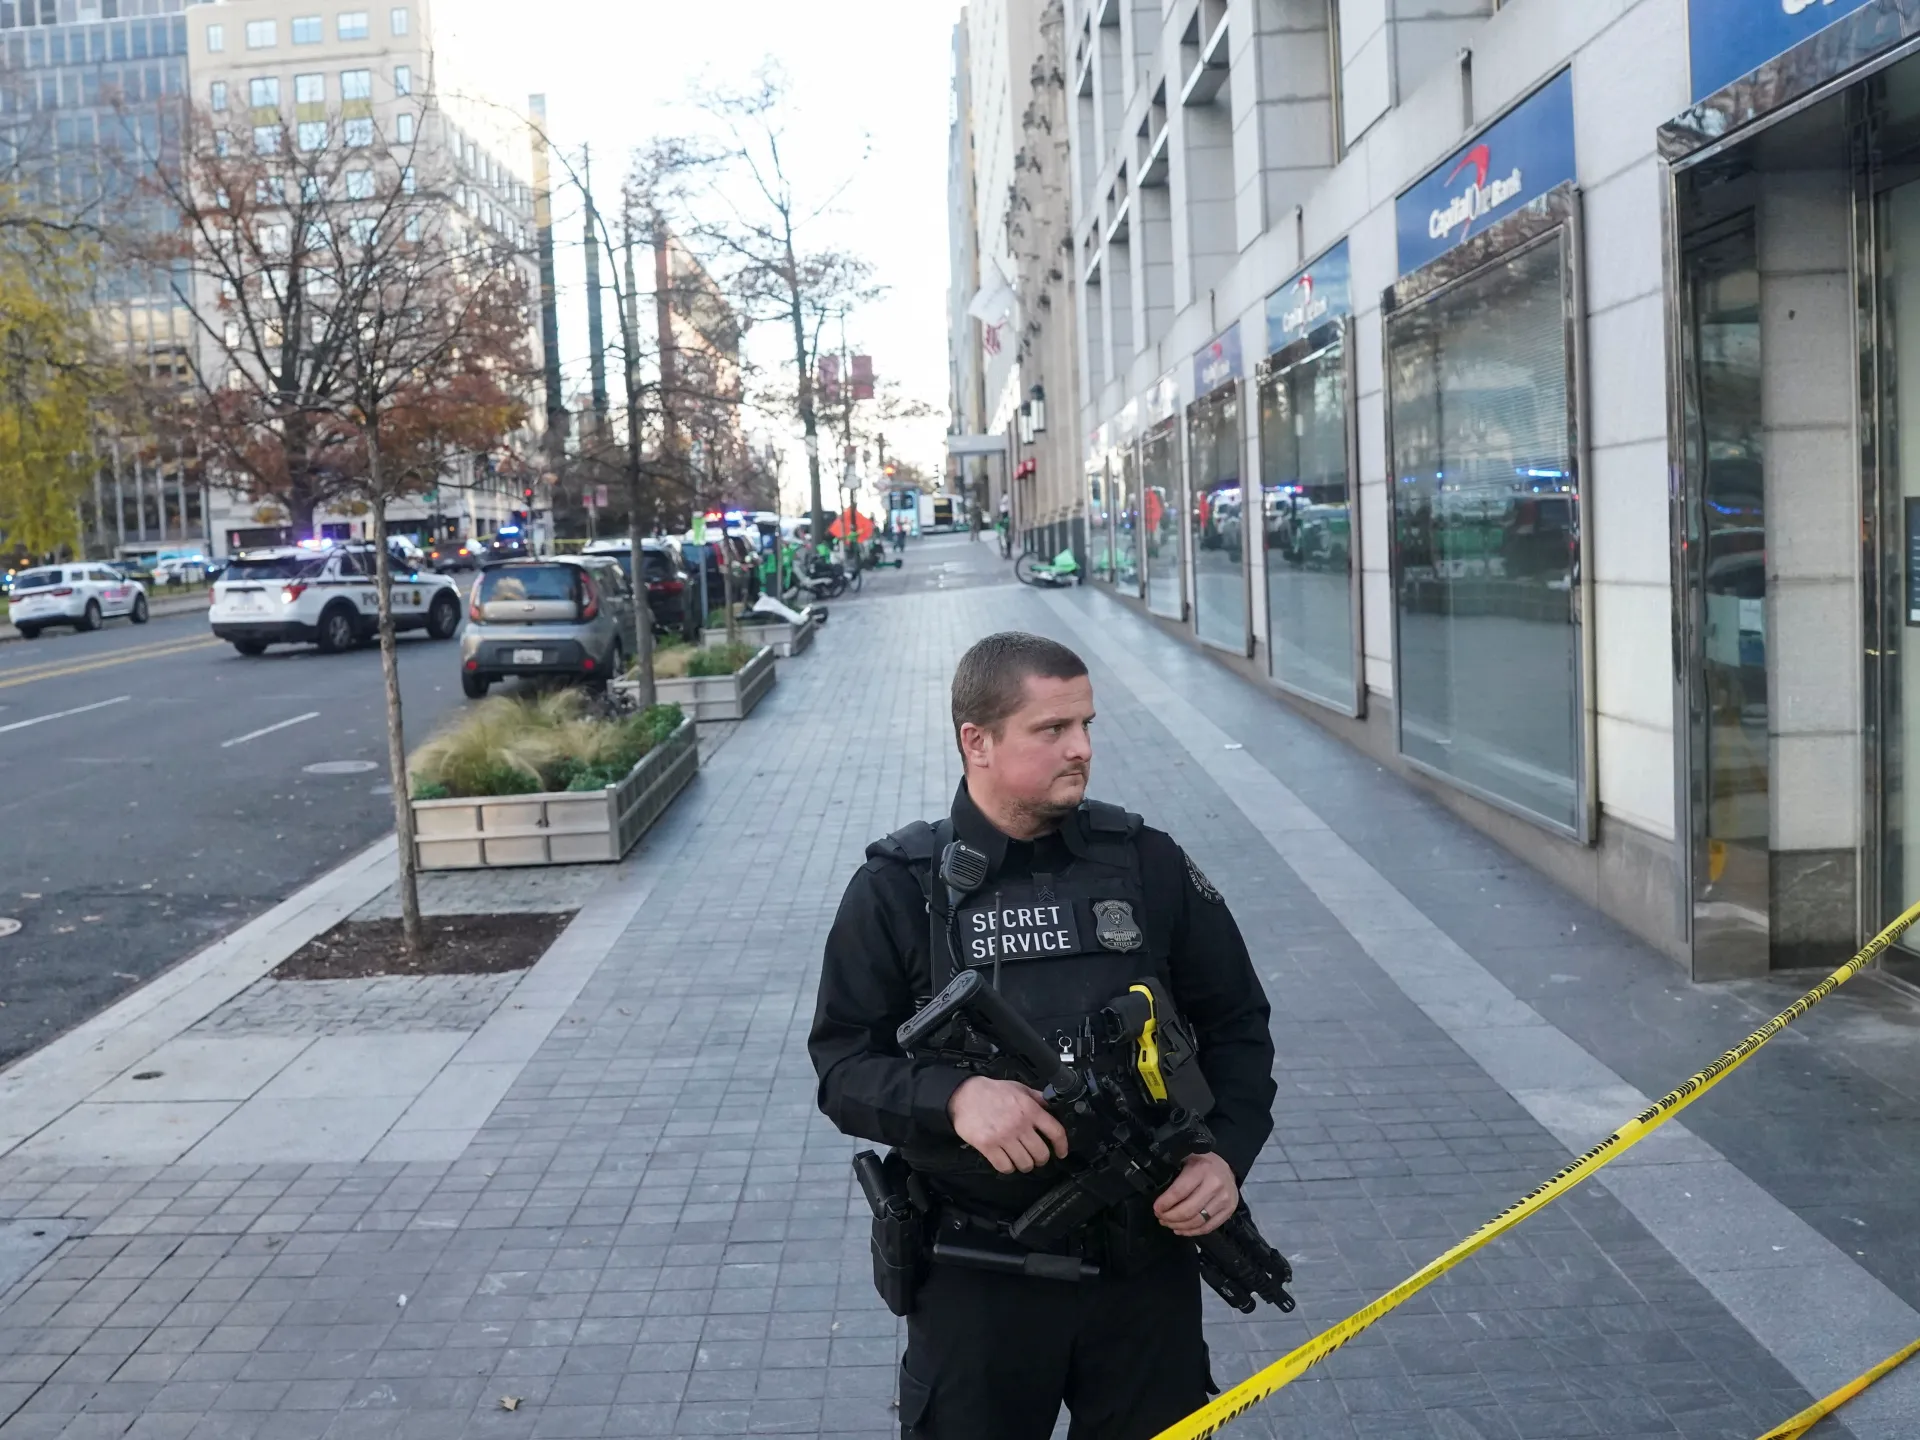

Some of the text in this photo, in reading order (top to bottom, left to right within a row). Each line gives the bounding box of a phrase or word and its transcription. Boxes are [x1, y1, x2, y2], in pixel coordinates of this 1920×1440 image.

[361, 591, 409, 606] POCE
[972, 906, 1060, 933] SECRET
[971, 930, 1072, 959] SERVICE
